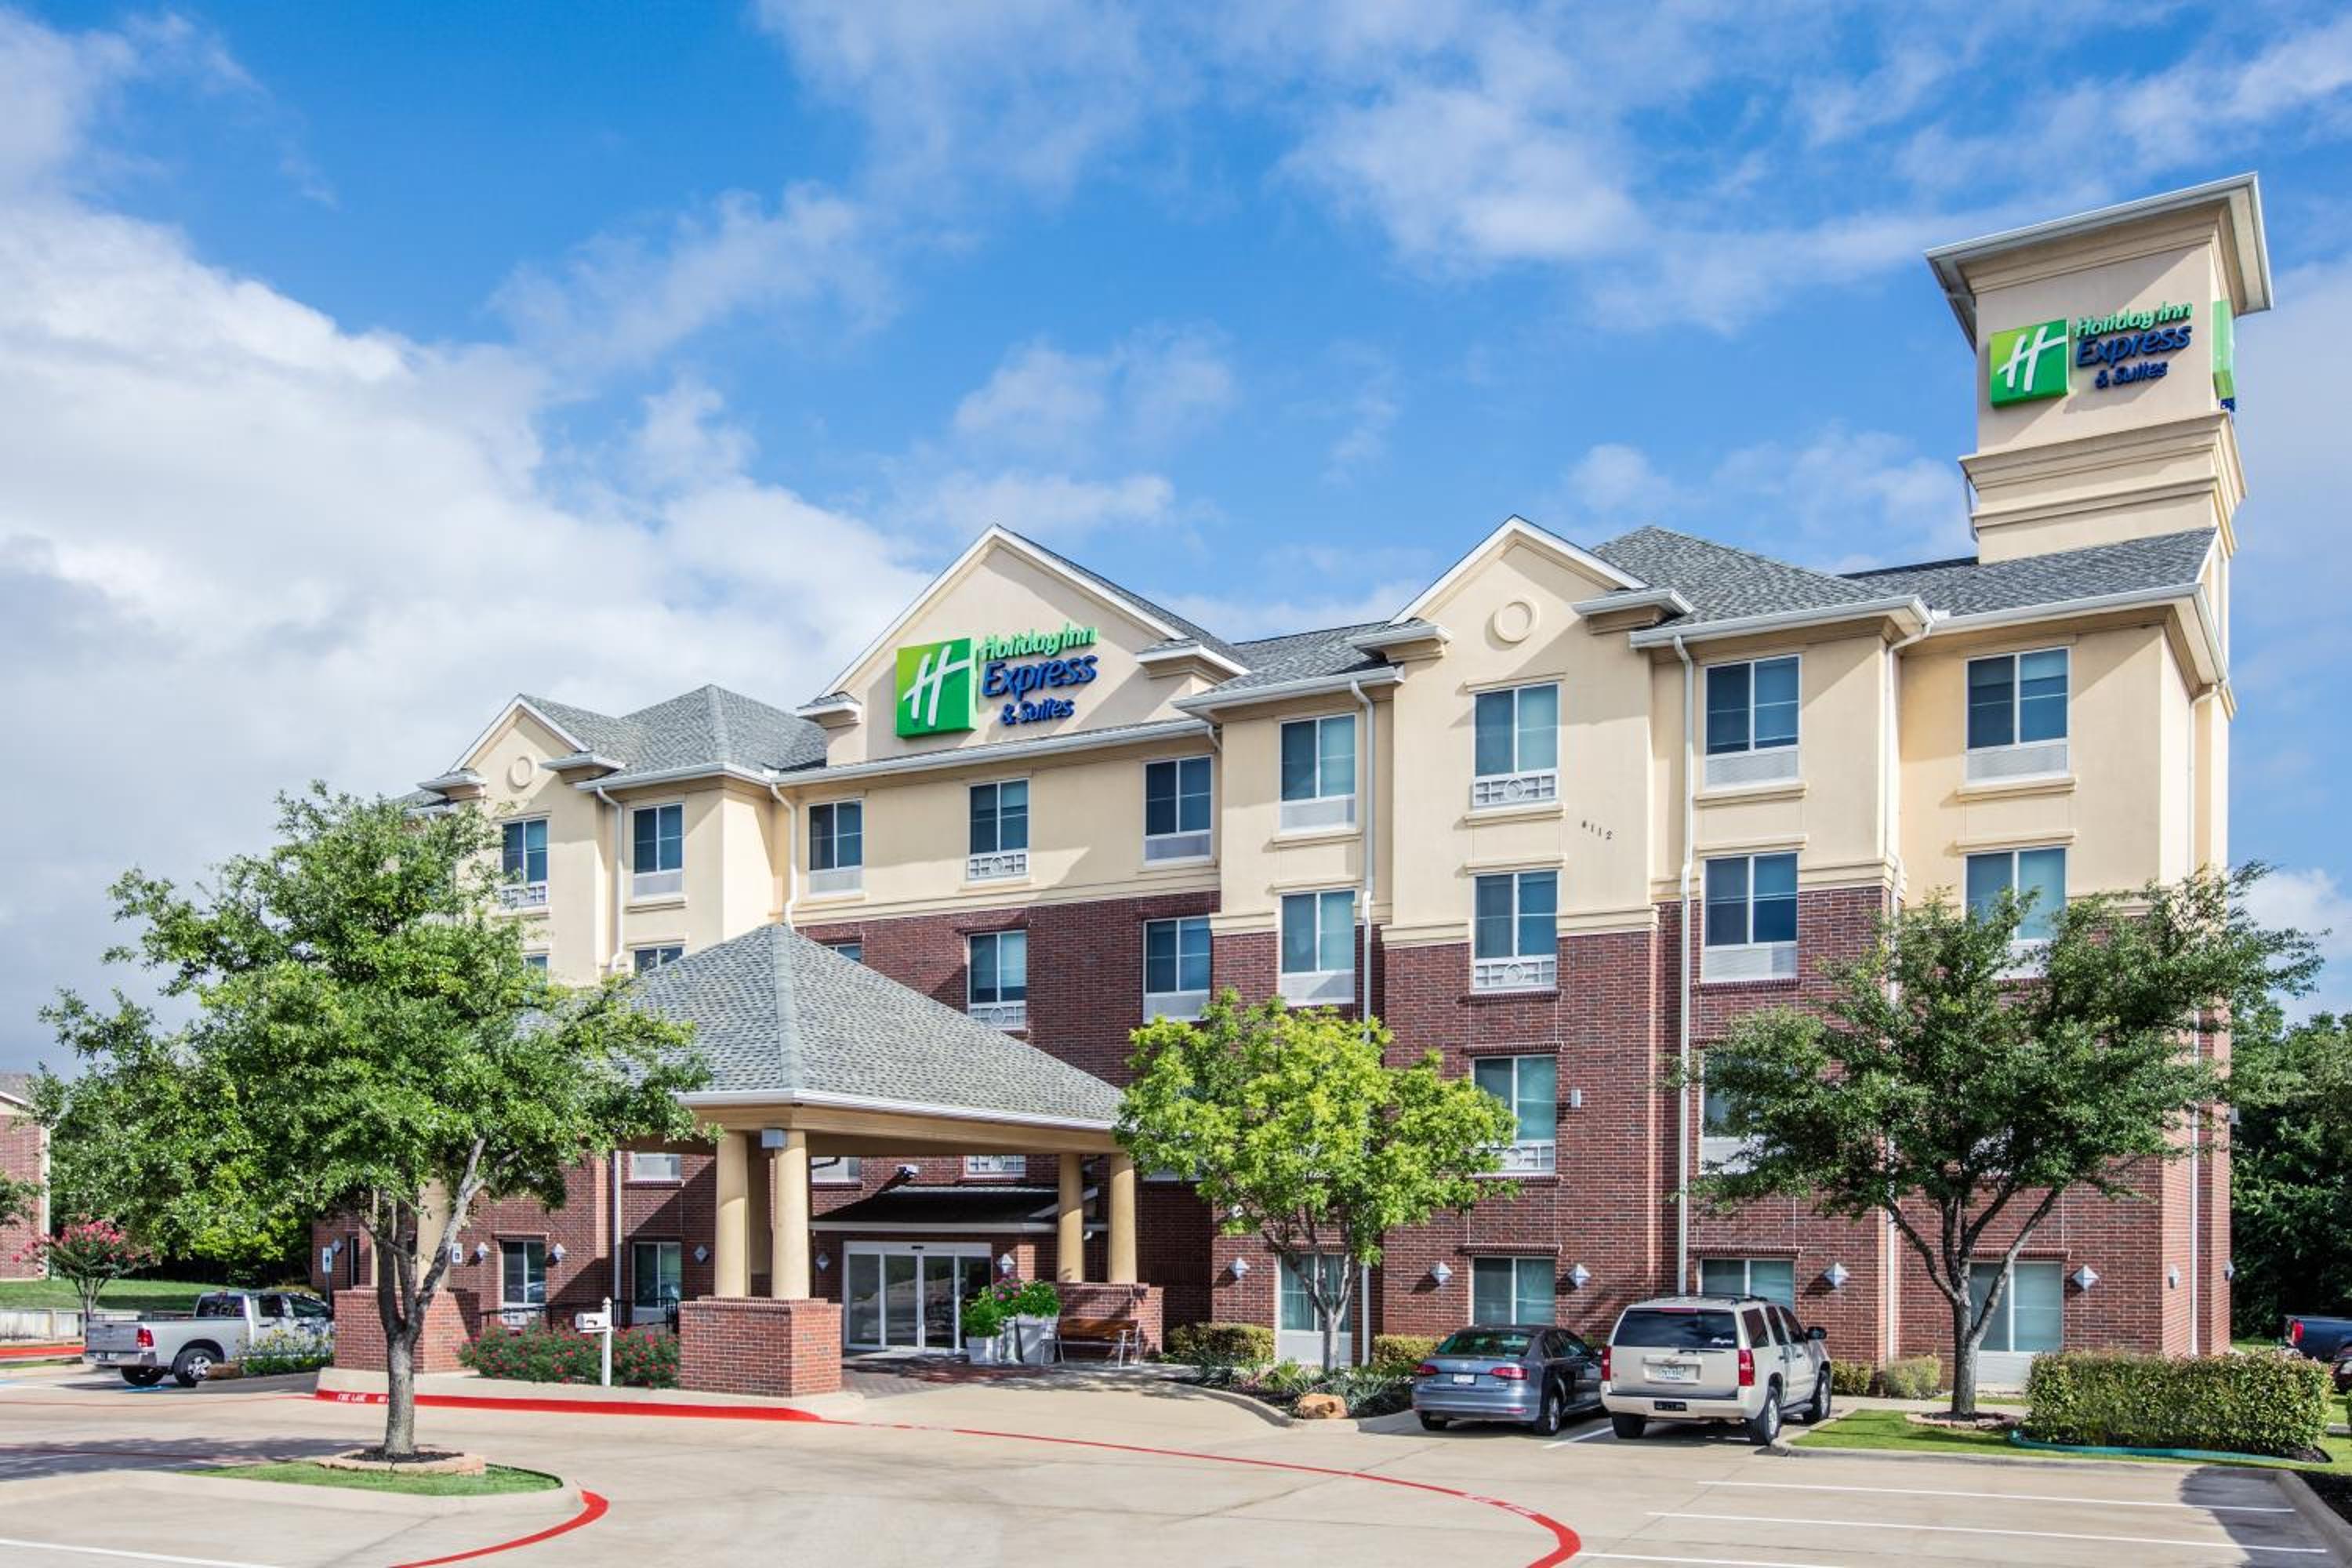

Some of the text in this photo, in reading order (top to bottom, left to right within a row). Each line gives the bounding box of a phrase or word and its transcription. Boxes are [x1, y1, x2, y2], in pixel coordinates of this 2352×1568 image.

[2075, 308, 2154, 337] Holiday
[2076, 326, 2192, 368] Express
[2095, 361, 2169, 389] & Suites
[980, 629, 1062, 660] Holiday
[982, 655, 1098, 702] Express
[1001, 698, 1075, 725] & Suites
